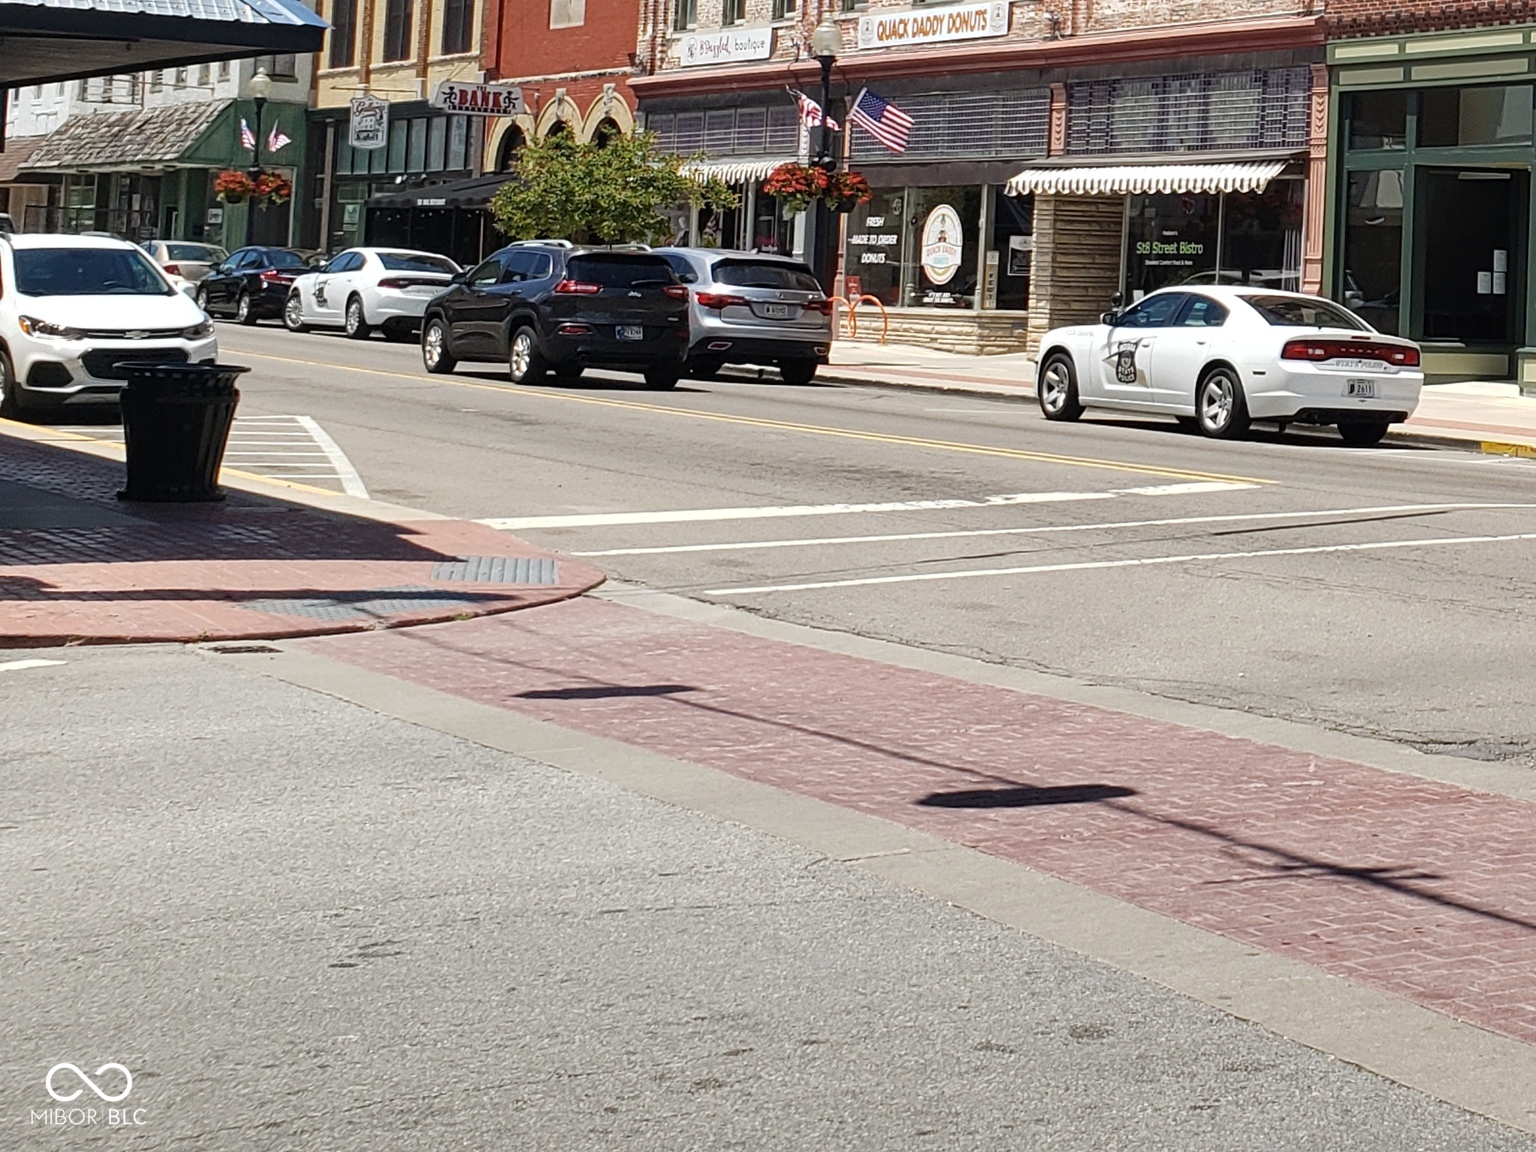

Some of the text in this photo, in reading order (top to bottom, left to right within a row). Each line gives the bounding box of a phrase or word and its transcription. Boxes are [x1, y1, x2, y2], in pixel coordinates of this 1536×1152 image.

[876, 8, 988, 42] QUACK DADDY DONUTS
[734, 37, 766, 55] boutique
[458, 89, 502, 109] BANK
[1136, 241, 1204, 255] St8 Street Bistro
[861, 252, 886, 264] DONUTS
[1117, 365, 1135, 375] STATE
